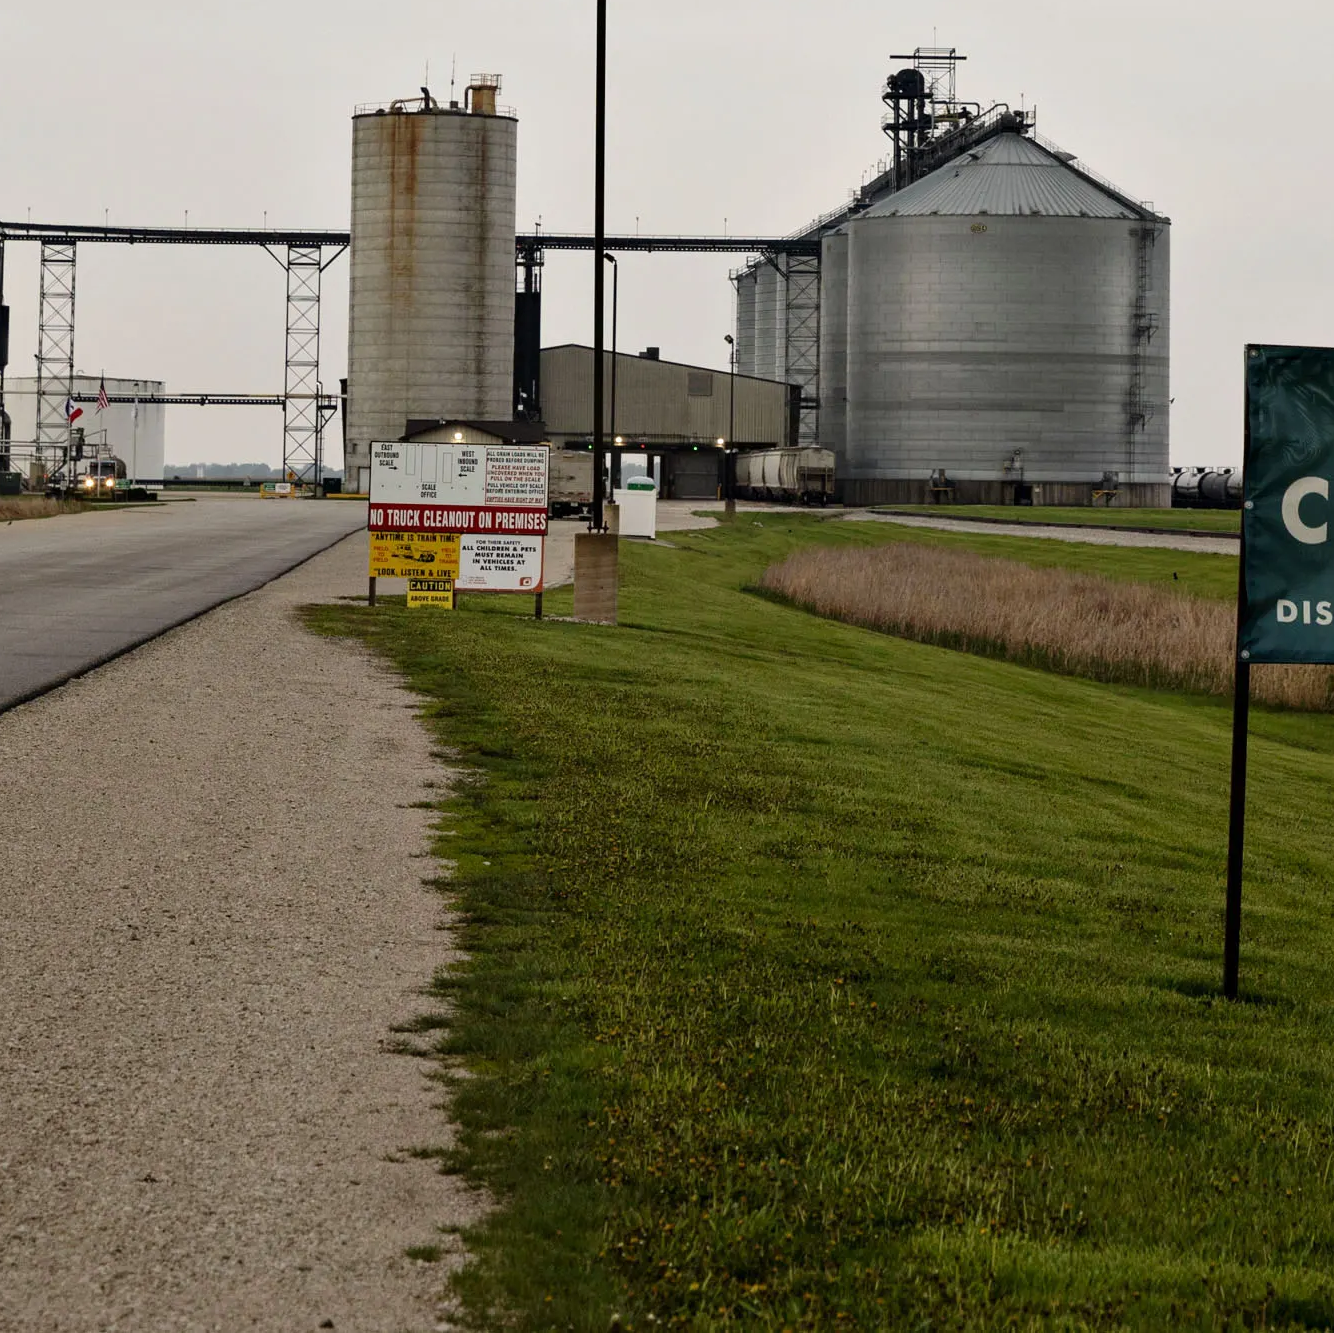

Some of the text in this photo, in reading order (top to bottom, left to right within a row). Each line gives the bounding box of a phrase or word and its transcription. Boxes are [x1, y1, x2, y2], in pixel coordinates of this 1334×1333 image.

[370, 509, 547, 530] NO TRUCK CLEANOUT ON PREMISES
[410, 581, 451, 590] CAUTION
